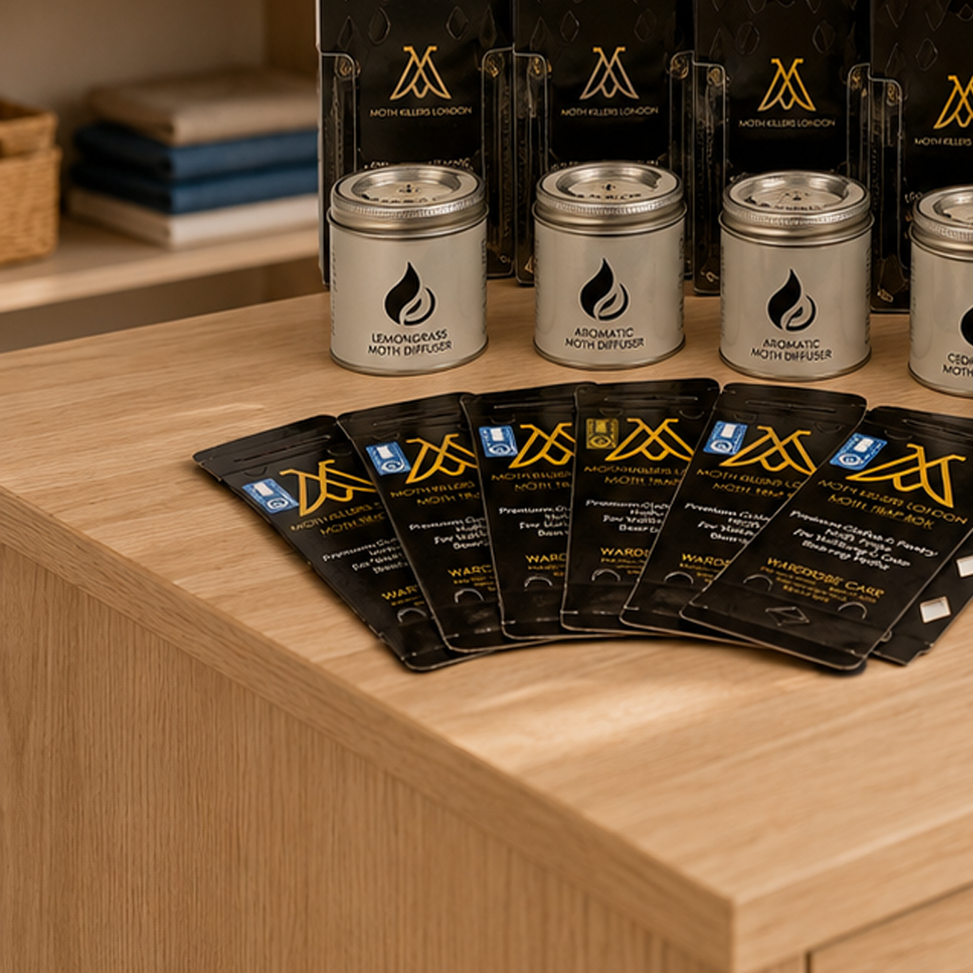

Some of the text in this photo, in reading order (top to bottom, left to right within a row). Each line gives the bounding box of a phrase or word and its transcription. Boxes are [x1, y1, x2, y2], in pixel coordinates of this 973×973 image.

[371, 329, 448, 344] LEMONGRASS
[762, 338, 820, 350] AROMATIC
[368, 345, 401, 356] MOTH
[750, 348, 782, 360] MOTH
